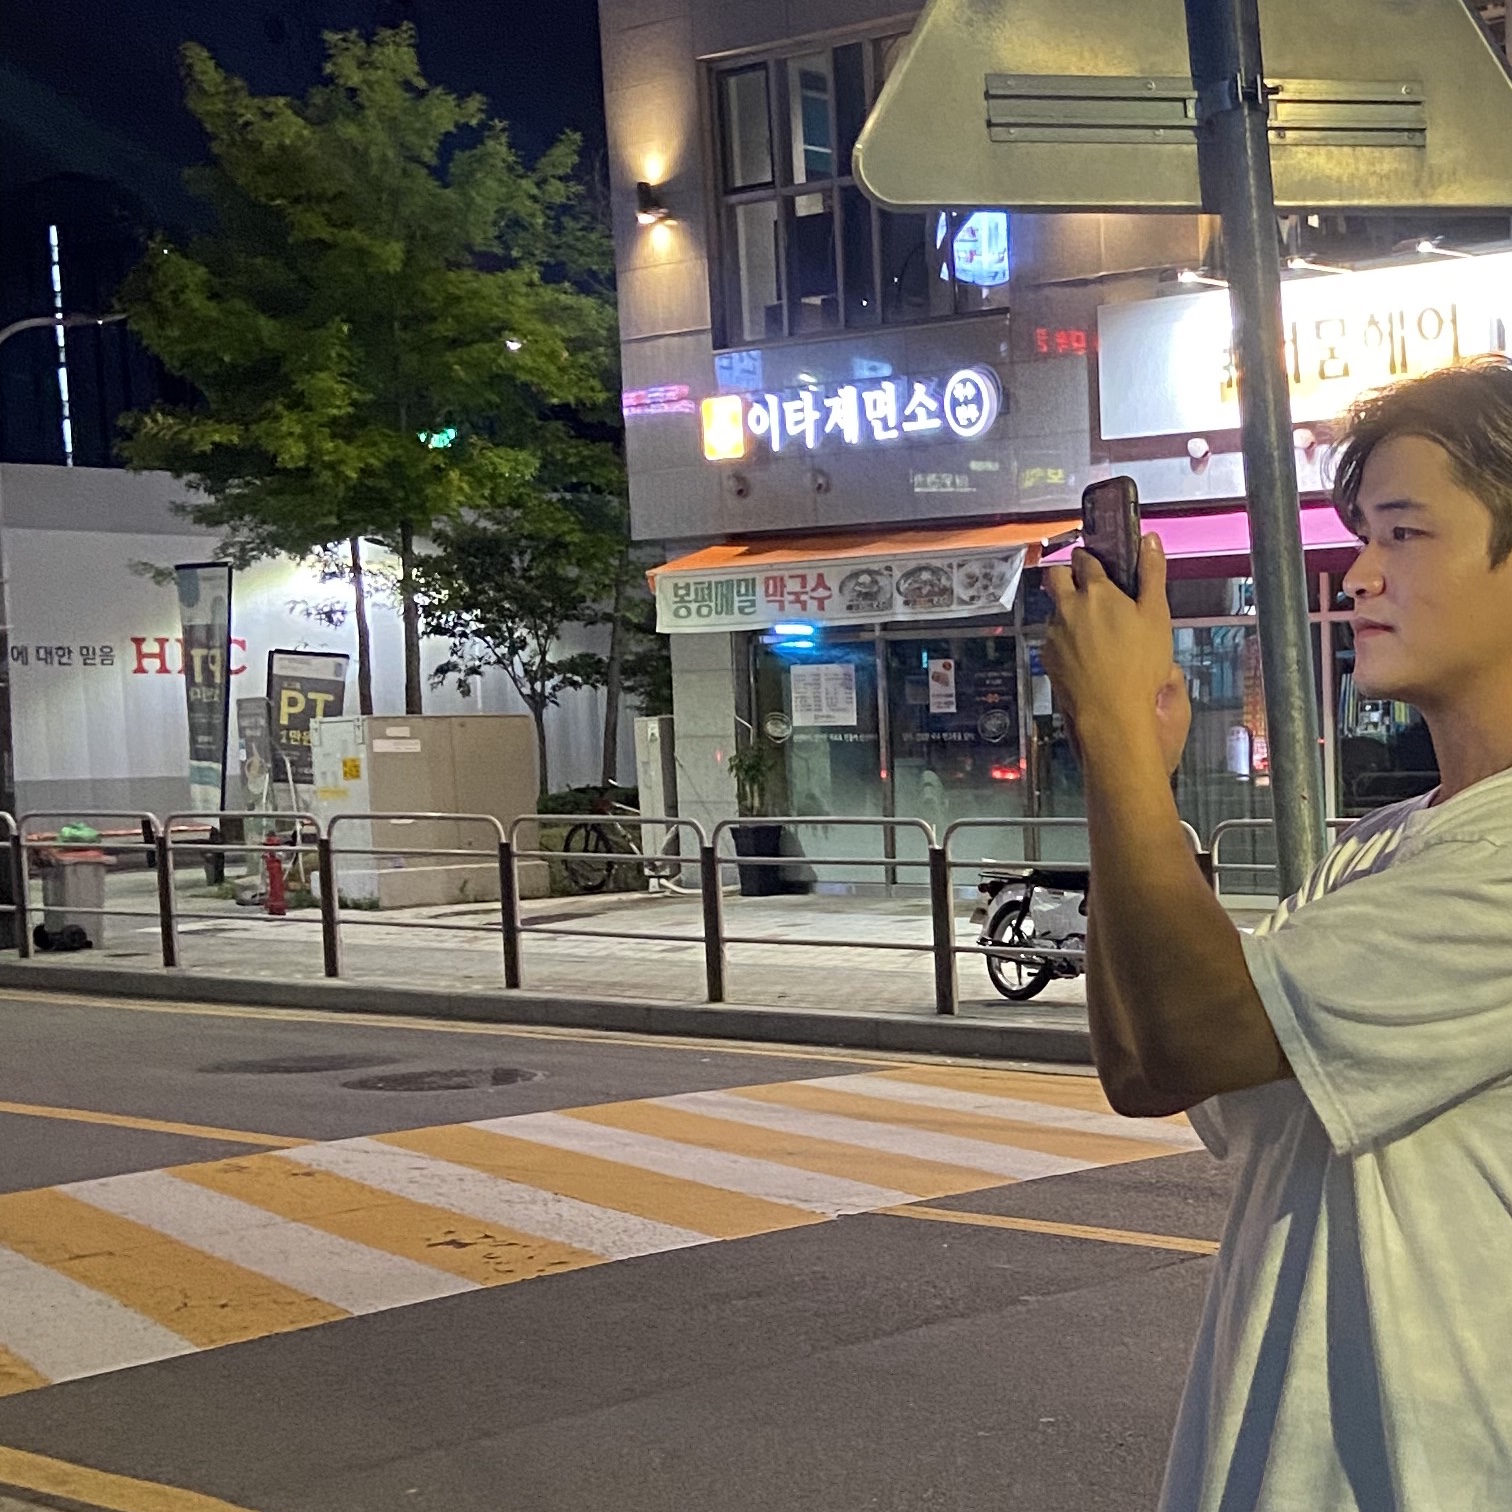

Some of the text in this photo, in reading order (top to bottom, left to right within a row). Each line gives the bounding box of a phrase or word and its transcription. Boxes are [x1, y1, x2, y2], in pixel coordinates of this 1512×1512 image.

[672, 572, 833, 620] 봉평메밀 막국수
[10, 645, 116, 666] 에 대한 믿음
[279, 688, 335, 726] PT
